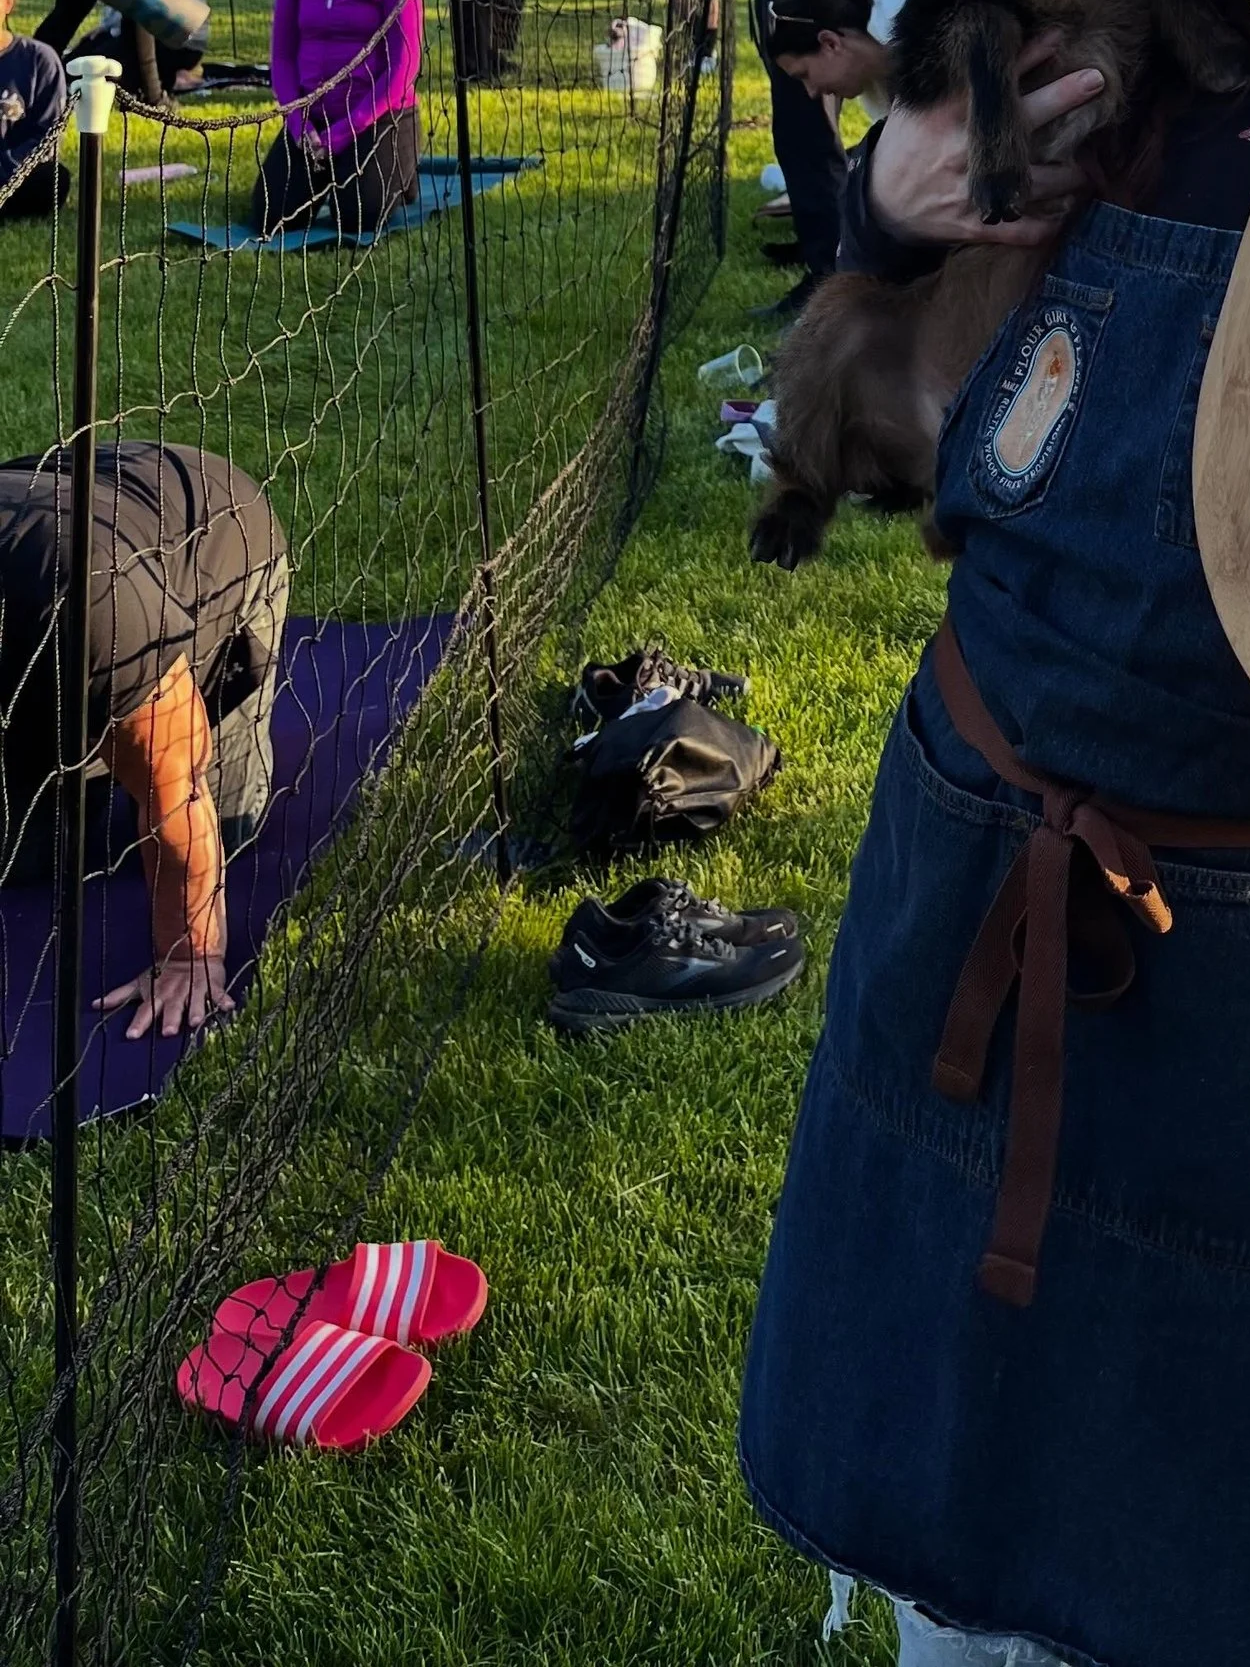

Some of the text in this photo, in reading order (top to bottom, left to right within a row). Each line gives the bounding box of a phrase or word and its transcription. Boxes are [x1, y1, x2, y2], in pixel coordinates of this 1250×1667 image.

[1014, 324, 1045, 376] FLOUR
[1044, 310, 1069, 327] GIRL
[986, 397, 1010, 438] RUSTIC
